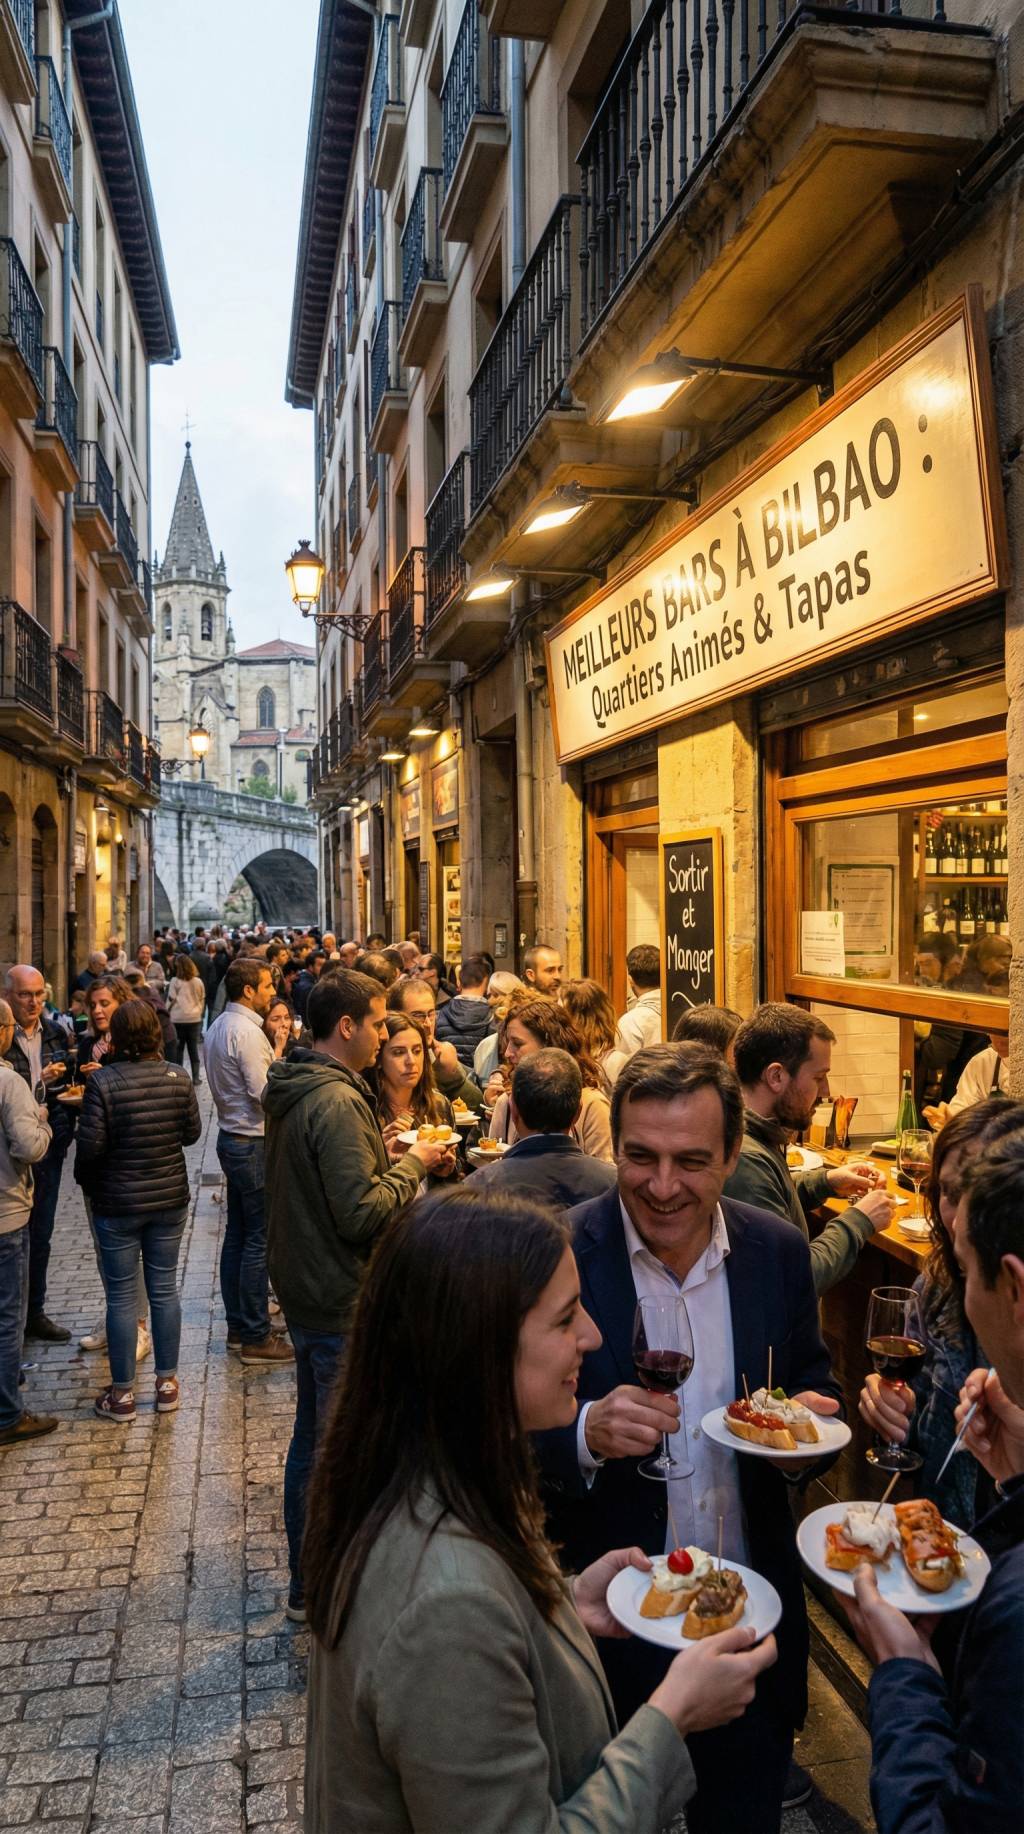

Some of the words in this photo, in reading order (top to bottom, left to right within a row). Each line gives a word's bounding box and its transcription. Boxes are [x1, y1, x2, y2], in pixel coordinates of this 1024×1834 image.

[563, 588, 657, 689] MEILLEURS
[662, 538, 727, 630] BARS
[732, 507, 756, 588] À
[761, 417, 901, 570] BILBAO
[592, 661, 665, 728] Quartiers
[670, 610, 745, 686] Animés
[753, 592, 774, 644] &
[778, 550, 871, 631] Tapas
[668, 852, 709, 893] Sortir
[682, 898, 696, 928] et
[667, 934, 713, 989] Manger
